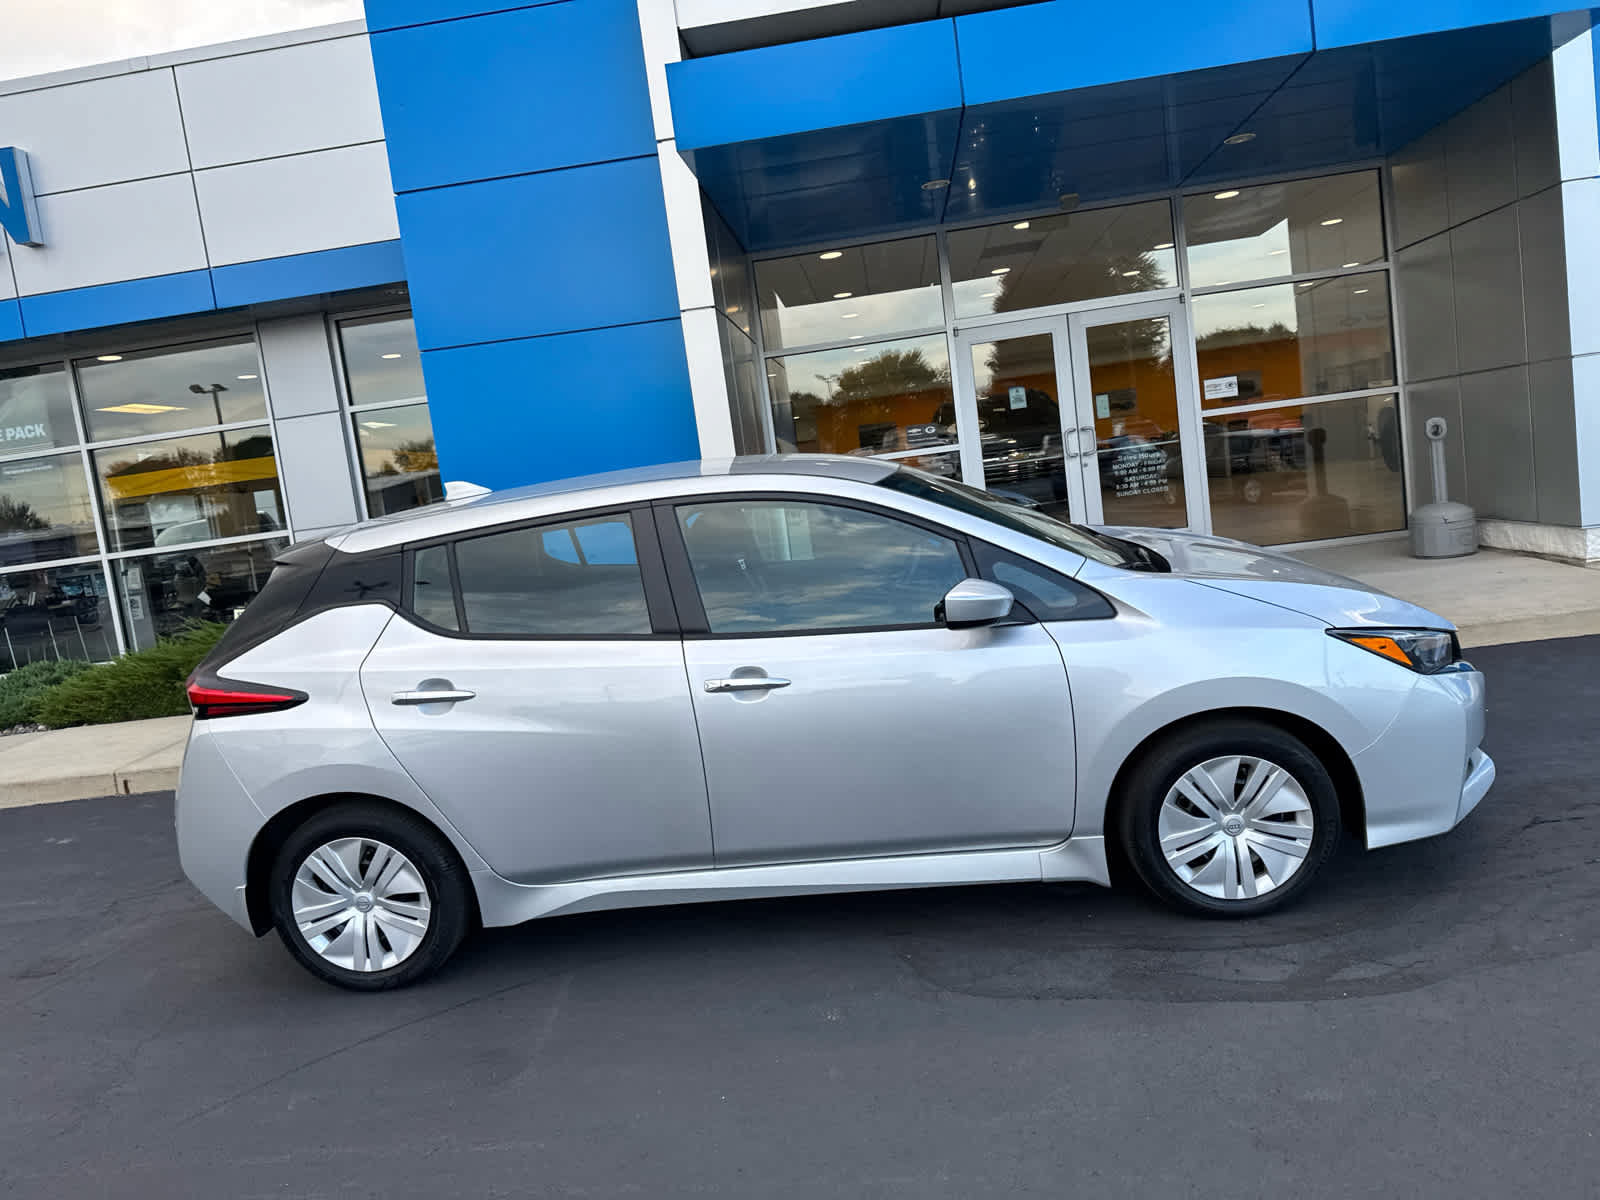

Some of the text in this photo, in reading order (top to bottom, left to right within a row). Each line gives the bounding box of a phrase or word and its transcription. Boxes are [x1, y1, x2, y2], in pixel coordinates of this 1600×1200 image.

[6, 424, 47, 440] PACK
[1112, 461, 1139, 470] MONDAY
[1144, 458, 1167, 466] FRIDAY
[1116, 485, 1169, 497] SUNDAY CLOSED
